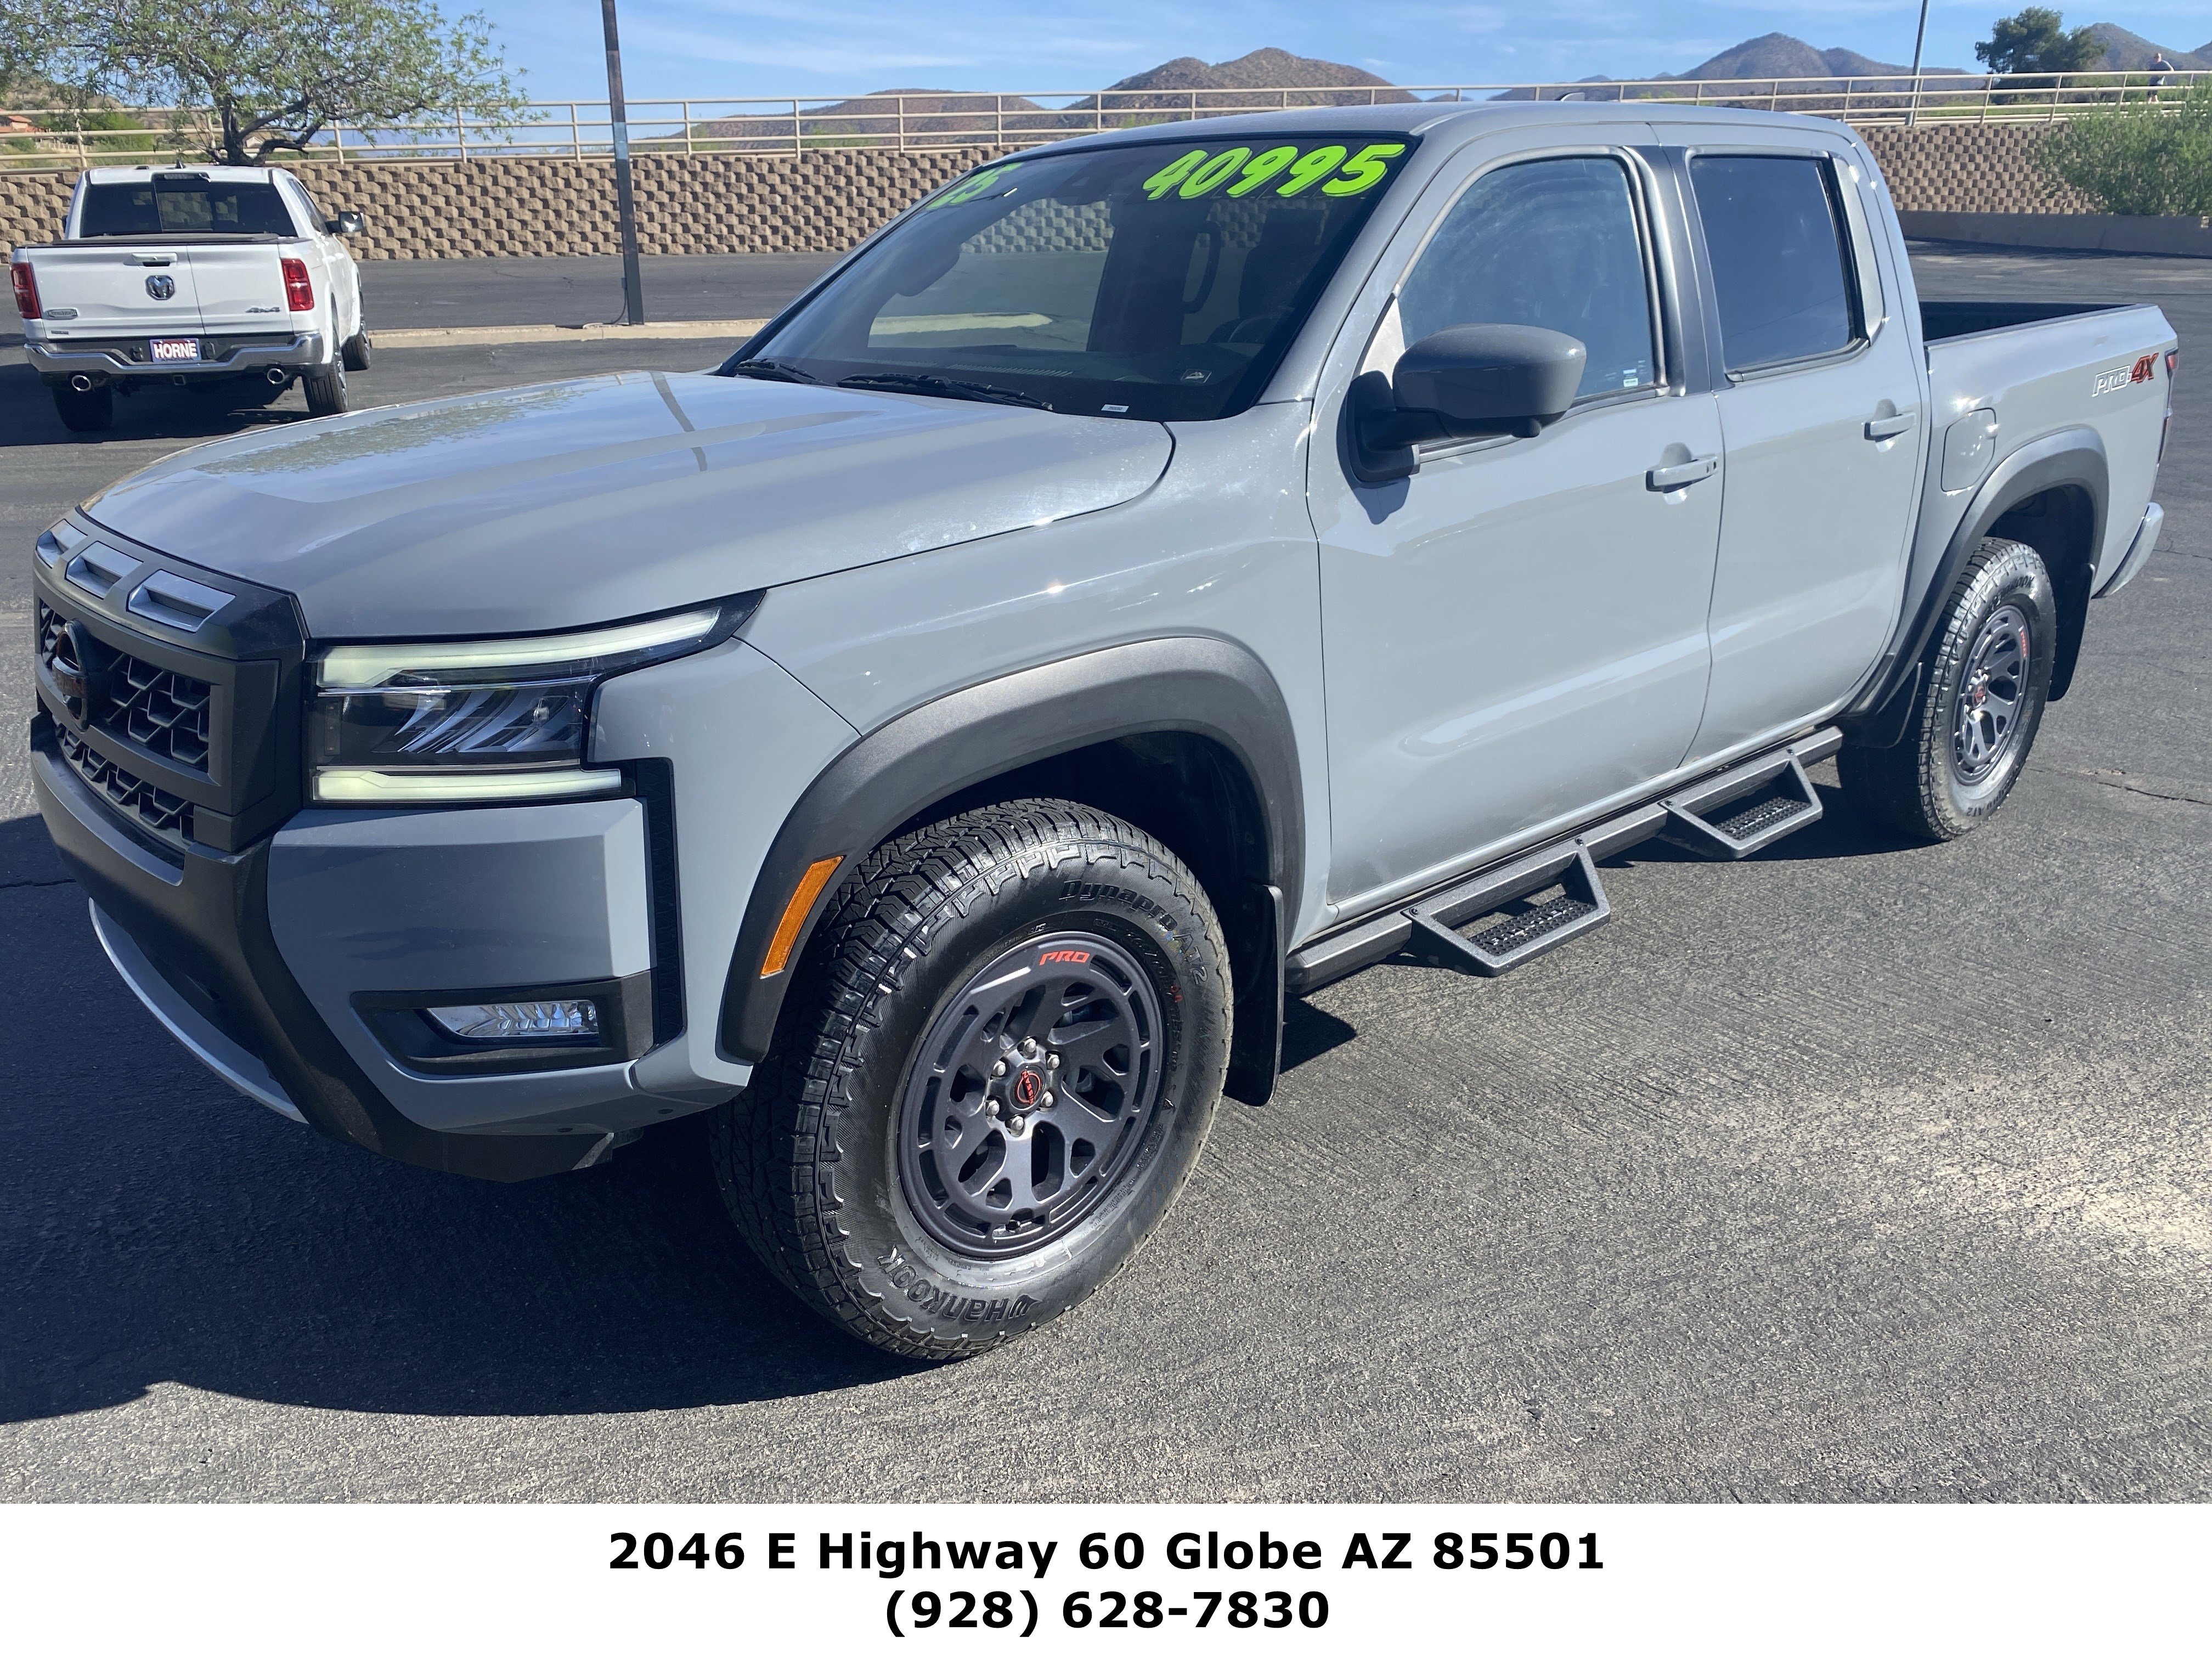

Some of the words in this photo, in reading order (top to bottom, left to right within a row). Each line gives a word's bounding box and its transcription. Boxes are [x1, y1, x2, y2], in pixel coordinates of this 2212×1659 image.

[1142, 143, 1406, 200] 40995
[153, 342, 198, 359] HORNE
[2091, 352, 2159, 397] PRO-4X
[1058, 879, 1178, 932] Dynapro
[1172, 933, 1208, 985] AT2
[1039, 950, 1090, 966] PRO
